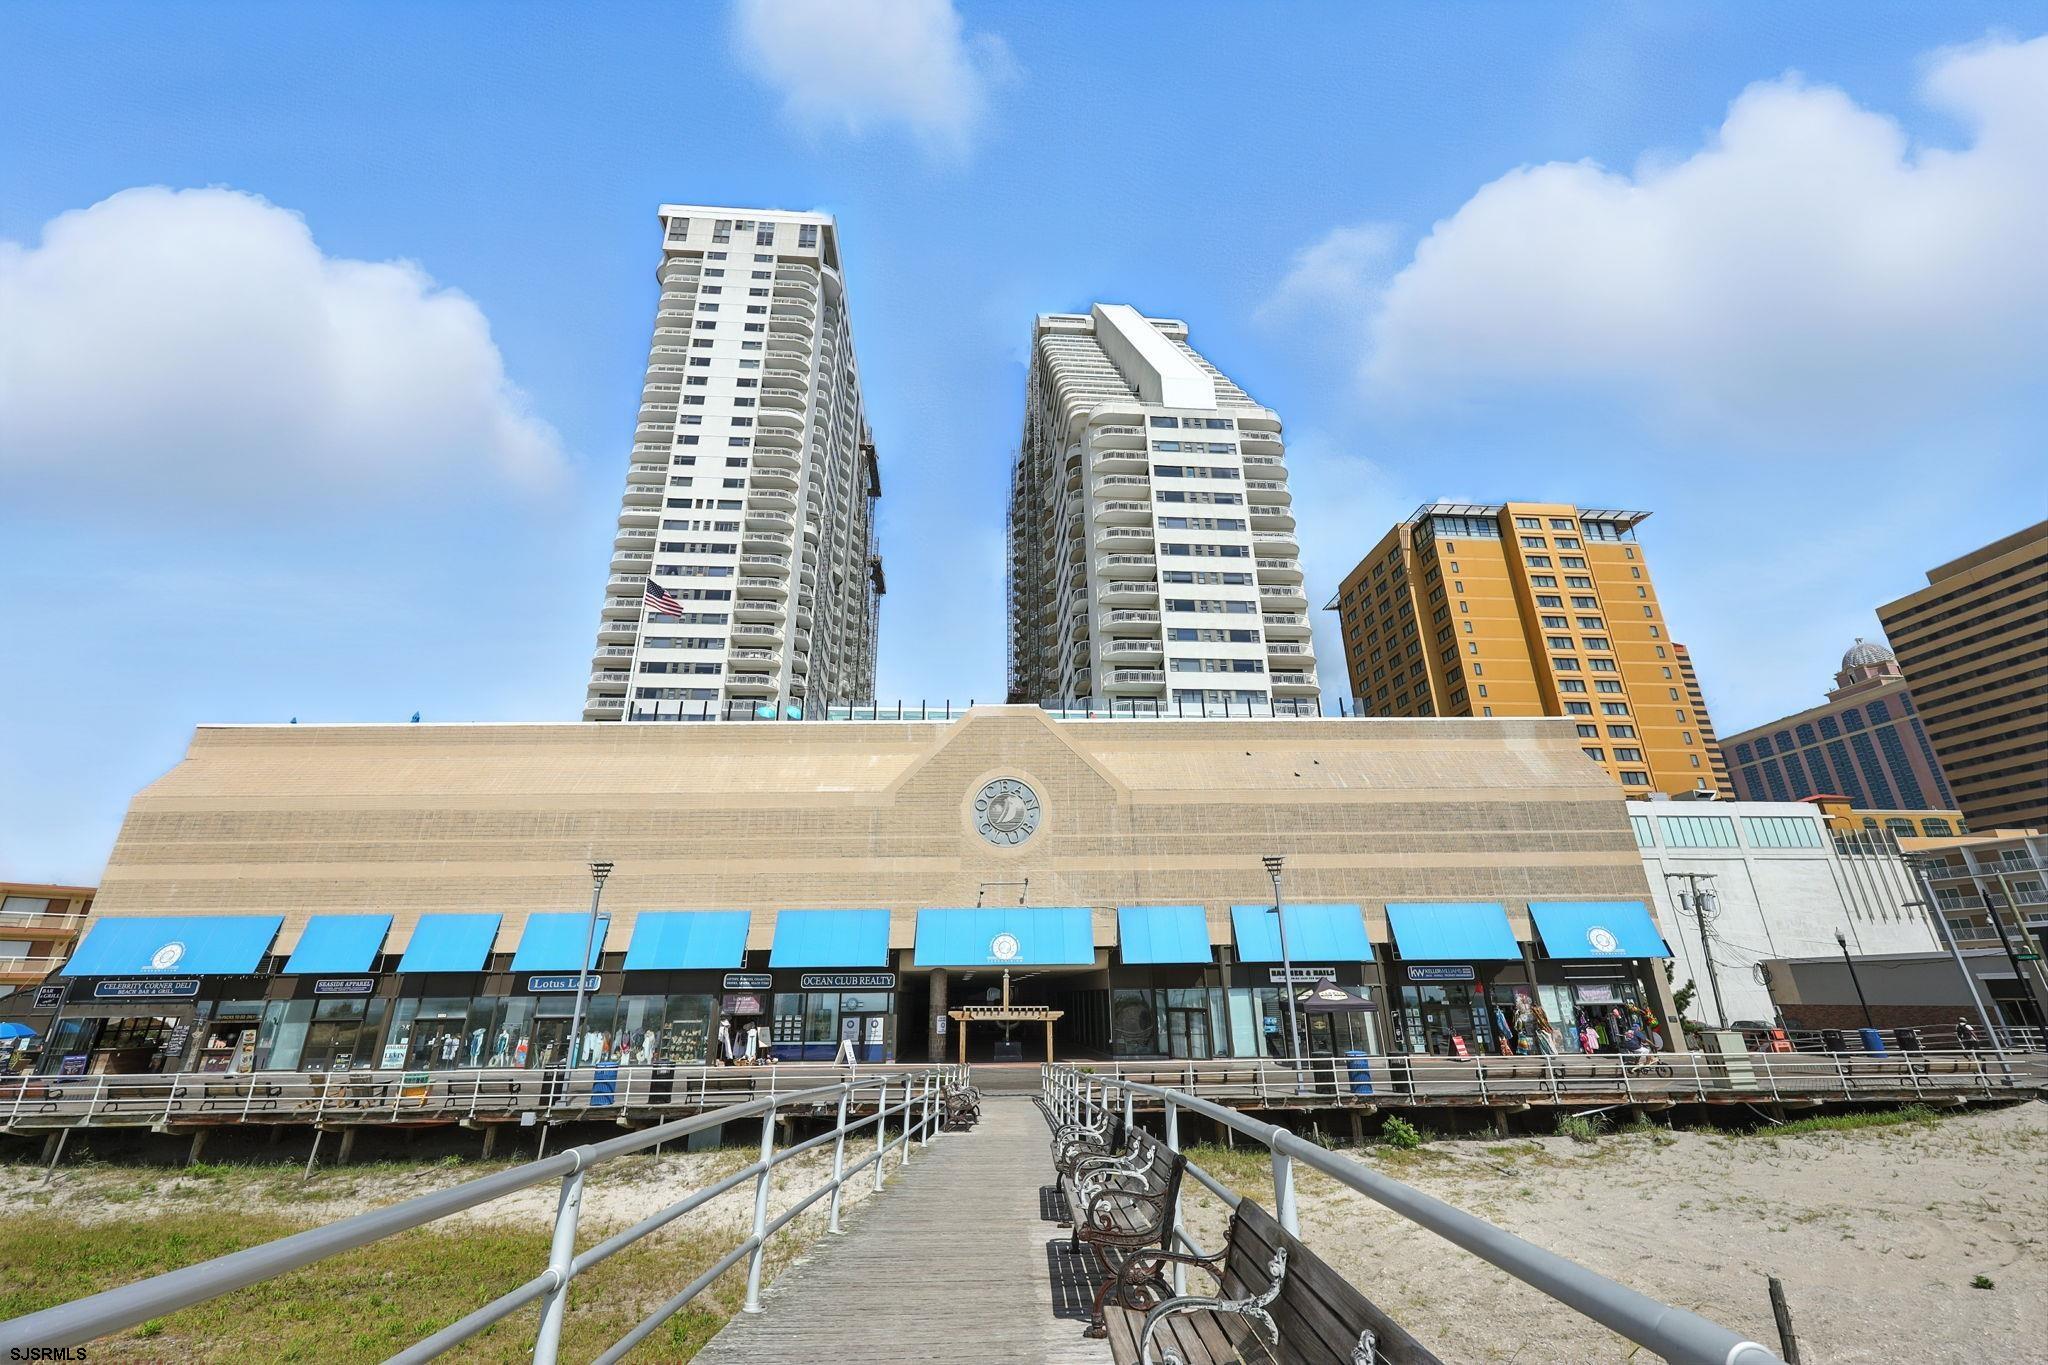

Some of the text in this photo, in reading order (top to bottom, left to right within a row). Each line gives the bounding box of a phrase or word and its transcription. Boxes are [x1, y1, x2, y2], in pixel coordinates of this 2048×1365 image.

[975, 781, 1039, 812] OCEAN
[979, 823, 1034, 845] CLUB
[534, 979, 565, 988] Lotus
[803, 976, 892, 985] OCEAN CLUB REALTY
[104, 982, 143, 990] CELEBRITY
